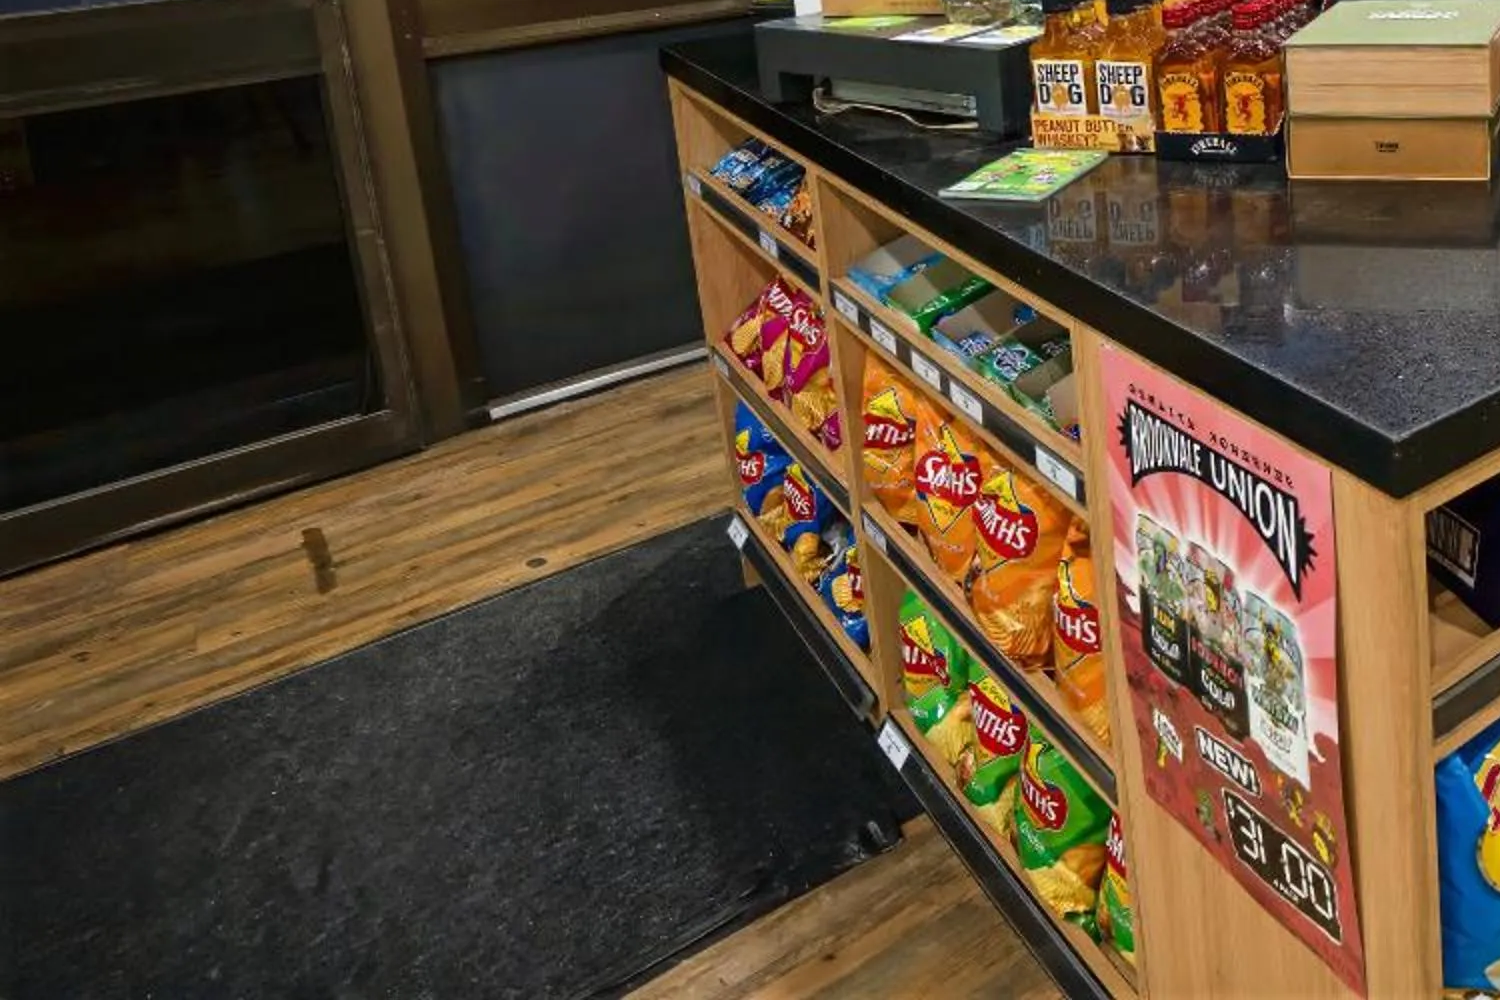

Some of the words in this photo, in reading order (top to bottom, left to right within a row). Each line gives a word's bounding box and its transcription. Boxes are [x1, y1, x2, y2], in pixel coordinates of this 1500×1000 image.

[1037, 63, 1079, 83] SHEEP
[1099, 63, 1143, 84] SHEEP
[1038, 83, 1083, 106] DOG
[1100, 84, 1145, 107] DOG
[1034, 119, 1081, 133] PEANUT
[1036, 132, 1100, 148] WHISKEY?
[1130, 402, 1203, 477] BROOKVALE
[1208, 452, 1298, 584] UNION
[1198, 733, 1258, 794] NEW!
